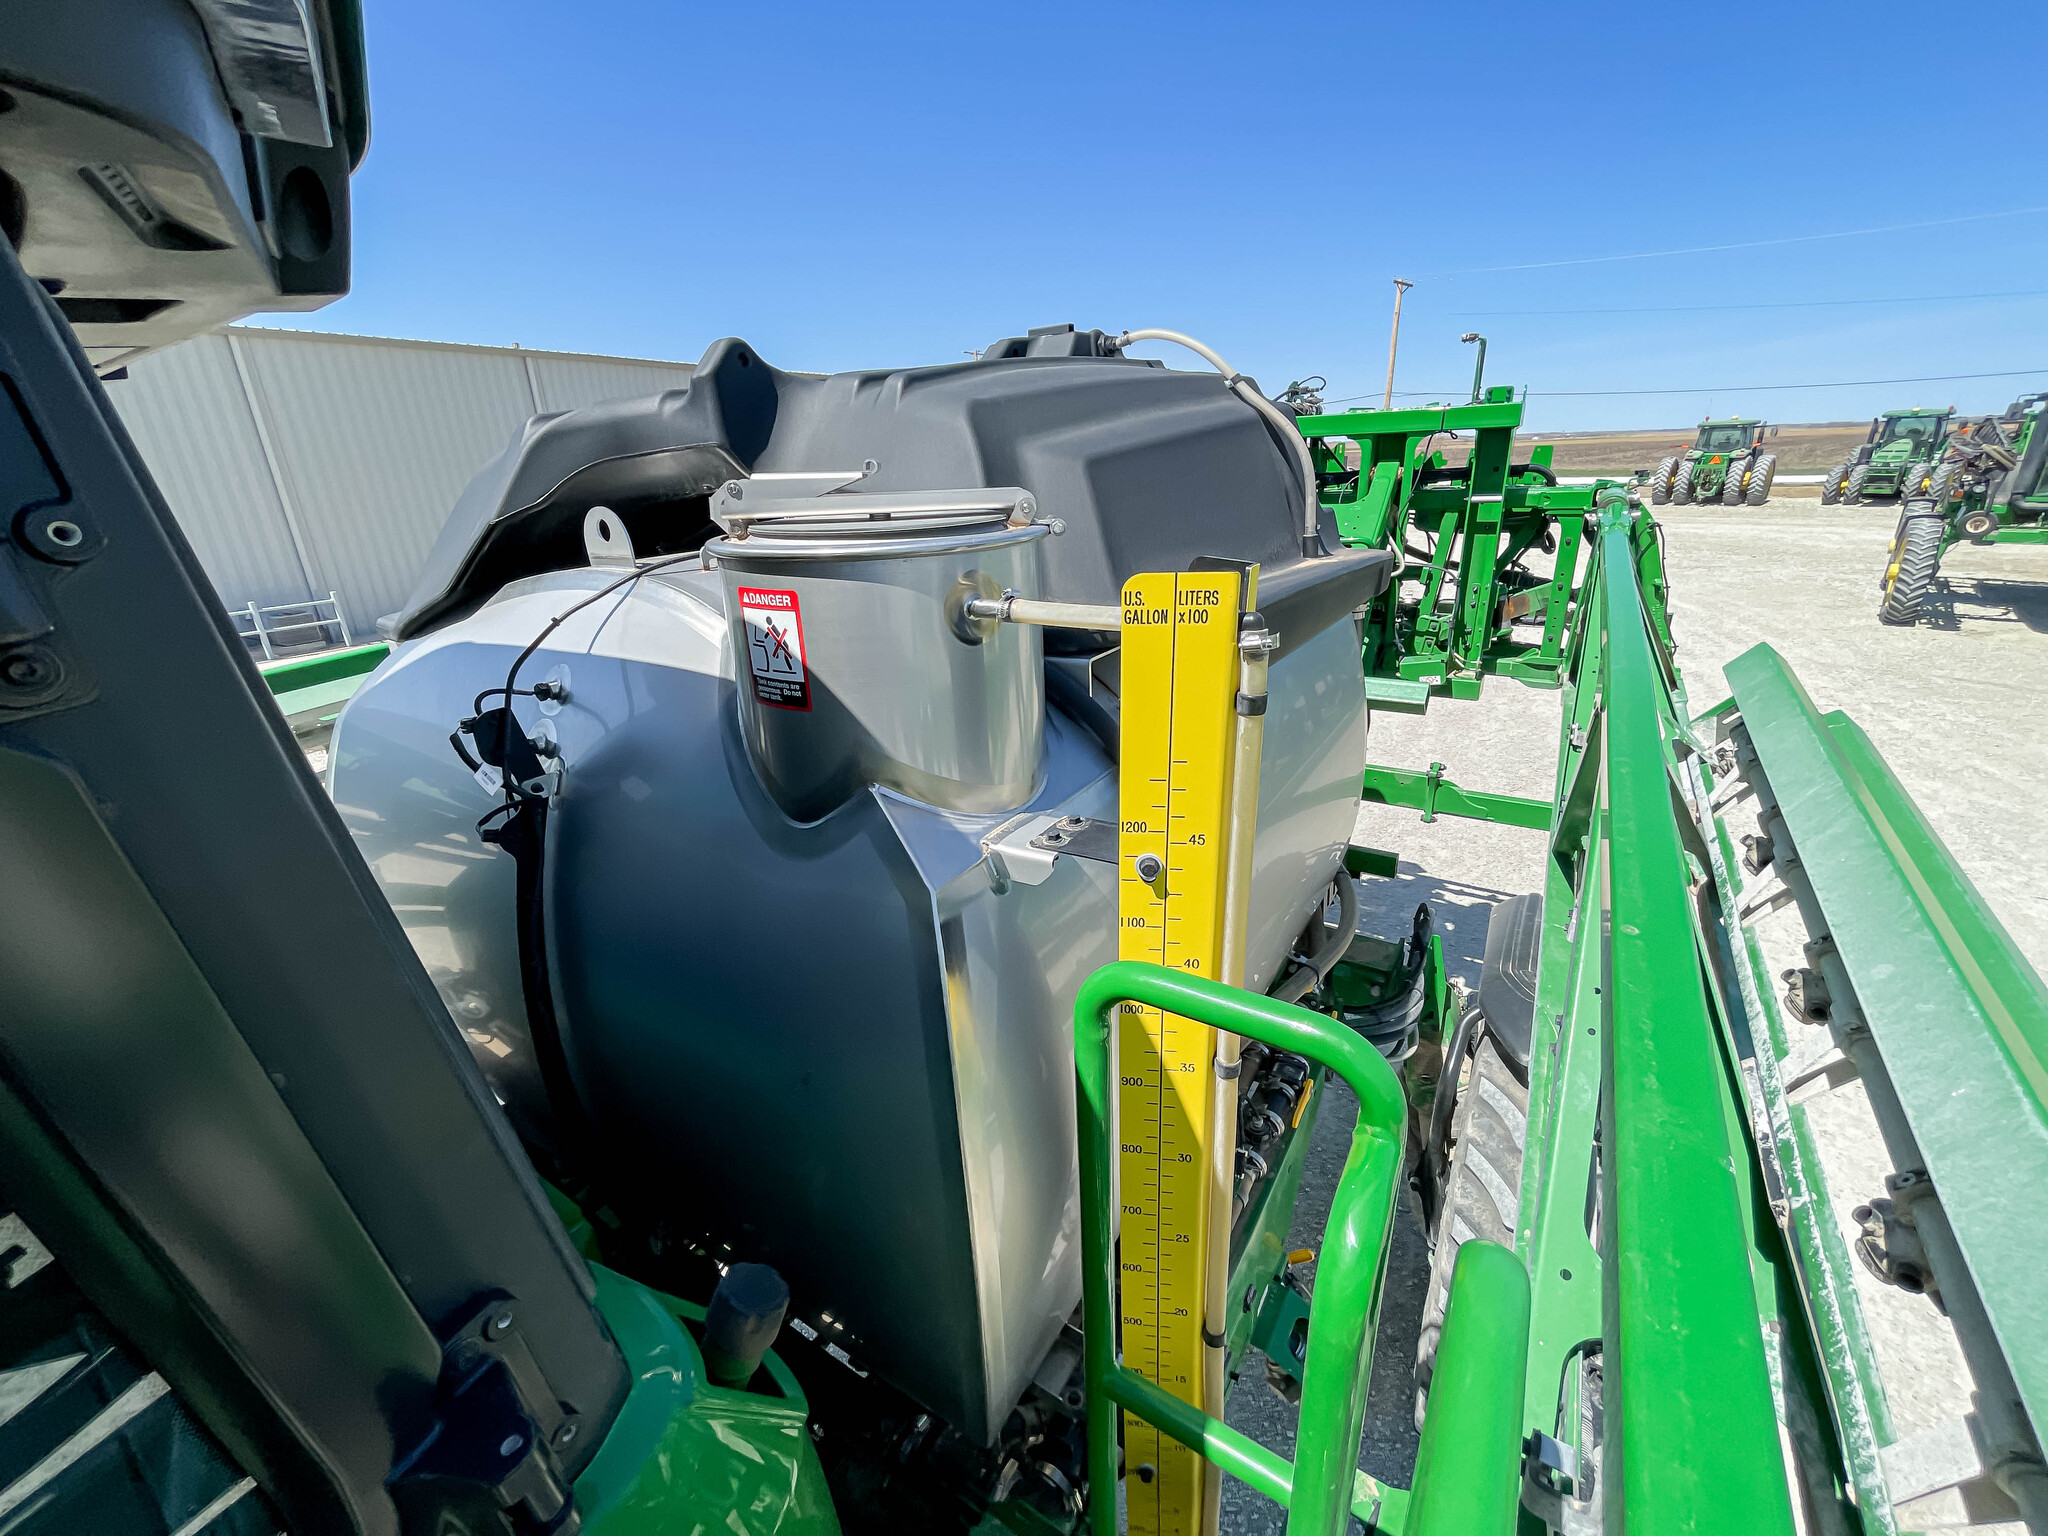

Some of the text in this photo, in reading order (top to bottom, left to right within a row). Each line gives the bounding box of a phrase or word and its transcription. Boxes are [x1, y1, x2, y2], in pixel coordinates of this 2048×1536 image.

[750, 593, 791, 607] DANGER
[1124, 591, 1145, 606] U.S.
[1179, 590, 1219, 606] LITERS
[1124, 609, 1168, 624] GALLON
[1178, 609, 1208, 624] x100
[1121, 821, 1147, 833] 1200
[1188, 834, 1206, 846] 45
[1120, 917, 1145, 928] 1100
[1183, 958, 1200, 969] 40
[1120, 1004, 1144, 1014] 1000
[1180, 1063, 1195, 1073] 35
[1121, 1076, 1143, 1087] 900
[1121, 1144, 1142, 1153] 800
[1178, 1153, 1192, 1163] 30
[1122, 1205, 1142, 1215] 700
[1175, 1233, 1190, 1243] 25
[1122, 1263, 1142, 1272] 600
[1174, 1308, 1188, 1317] 20
[1123, 1317, 1142, 1326] 500
[1175, 1375, 1187, 1383] 15
